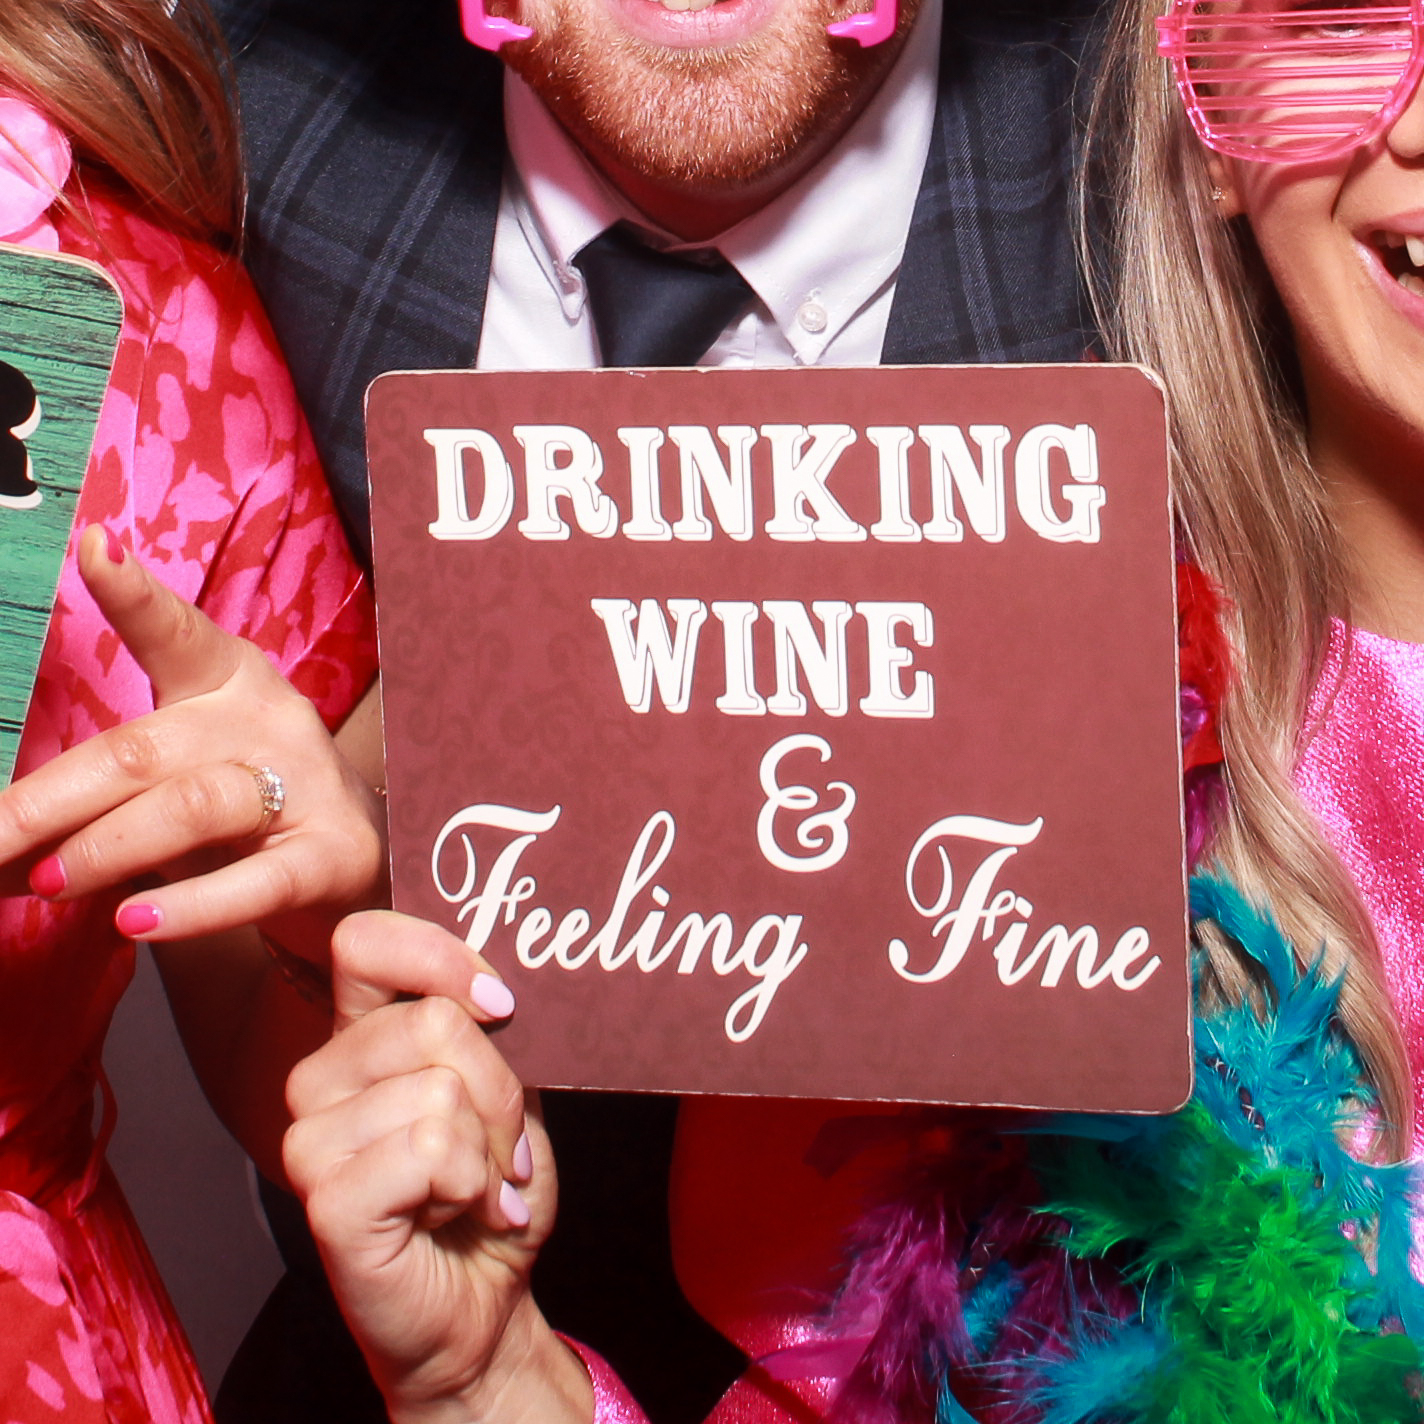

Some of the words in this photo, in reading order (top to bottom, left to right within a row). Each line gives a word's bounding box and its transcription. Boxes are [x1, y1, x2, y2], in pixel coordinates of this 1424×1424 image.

[423, 424, 1106, 544] DRINKING
[590, 598, 935, 718] WINE
[757, 733, 857, 872] &
[431, 804, 808, 1043] Feeling
[888, 815, 1161, 991] Fine
